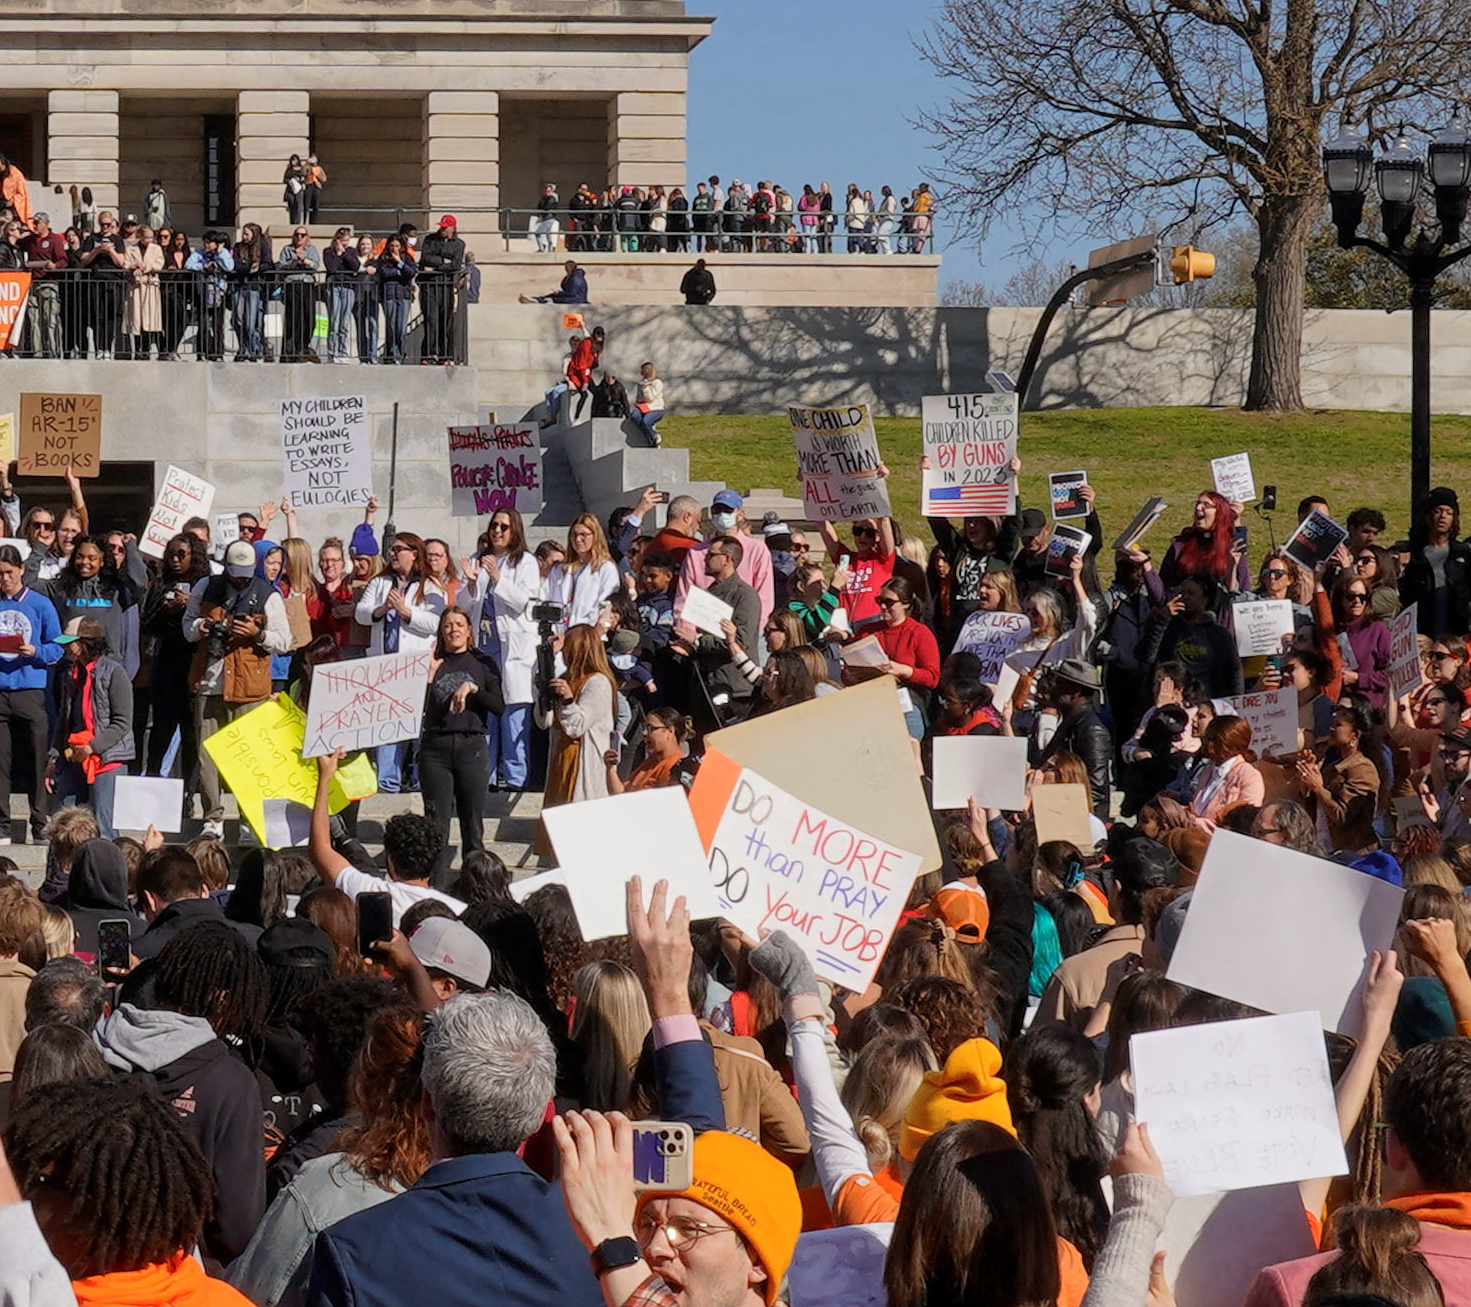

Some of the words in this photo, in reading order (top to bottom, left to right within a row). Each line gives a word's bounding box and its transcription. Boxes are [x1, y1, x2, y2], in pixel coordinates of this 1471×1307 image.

[41, 397, 76, 413] BAN
[281, 400, 302, 416] MY
[304, 397, 363, 413] CHILDREN
[284, 416, 336, 431] SHOULD
[344, 412, 364, 424] BE
[789, 407, 809, 428] ONE
[812, 407, 862, 430] CHILD
[44, 436, 79, 449] NOT
[284, 428, 350, 447] LEARNING
[925, 420, 970, 444] CHILDREN
[973, 420, 1014, 441] KILLED
[286, 448, 304, 459] TO
[309, 443, 354, 457] WRITE
[823, 435, 862, 451] WORTH
[35, 452, 93, 467] BOOKS
[799, 452, 830, 474] MORE
[831, 450, 878, 473] THAN
[938, 444, 957, 468] BY
[963, 443, 1005, 467] GUNS
[167, 471, 207, 496] Protect
[308, 470, 348, 487] NOT
[944, 471, 956, 482] IN
[962, 466, 1007, 485] 2023
[161, 489, 189, 513] Kids
[291, 488, 370, 507] EULOGIES
[473, 487, 517, 515] NOW
[806, 480, 839, 504] ALL
[840, 485, 855, 495] the
[154, 512, 178, 525] Not
[820, 506, 835, 516] on
[840, 503, 879, 518] EARTH
[992, 613, 1025, 632] LIVES
[308, 716, 417, 755] ACTION
[732, 779, 773, 826] DO
[791, 809, 903, 891] MORE
[744, 827, 805, 883] than
[817, 868, 888, 919] PRAY
[709, 846, 750, 903] DO
[820, 912, 884, 961] JOB
[701, 1192, 735, 1216] Seattle
[731, 1198, 757, 1228] BREAD
